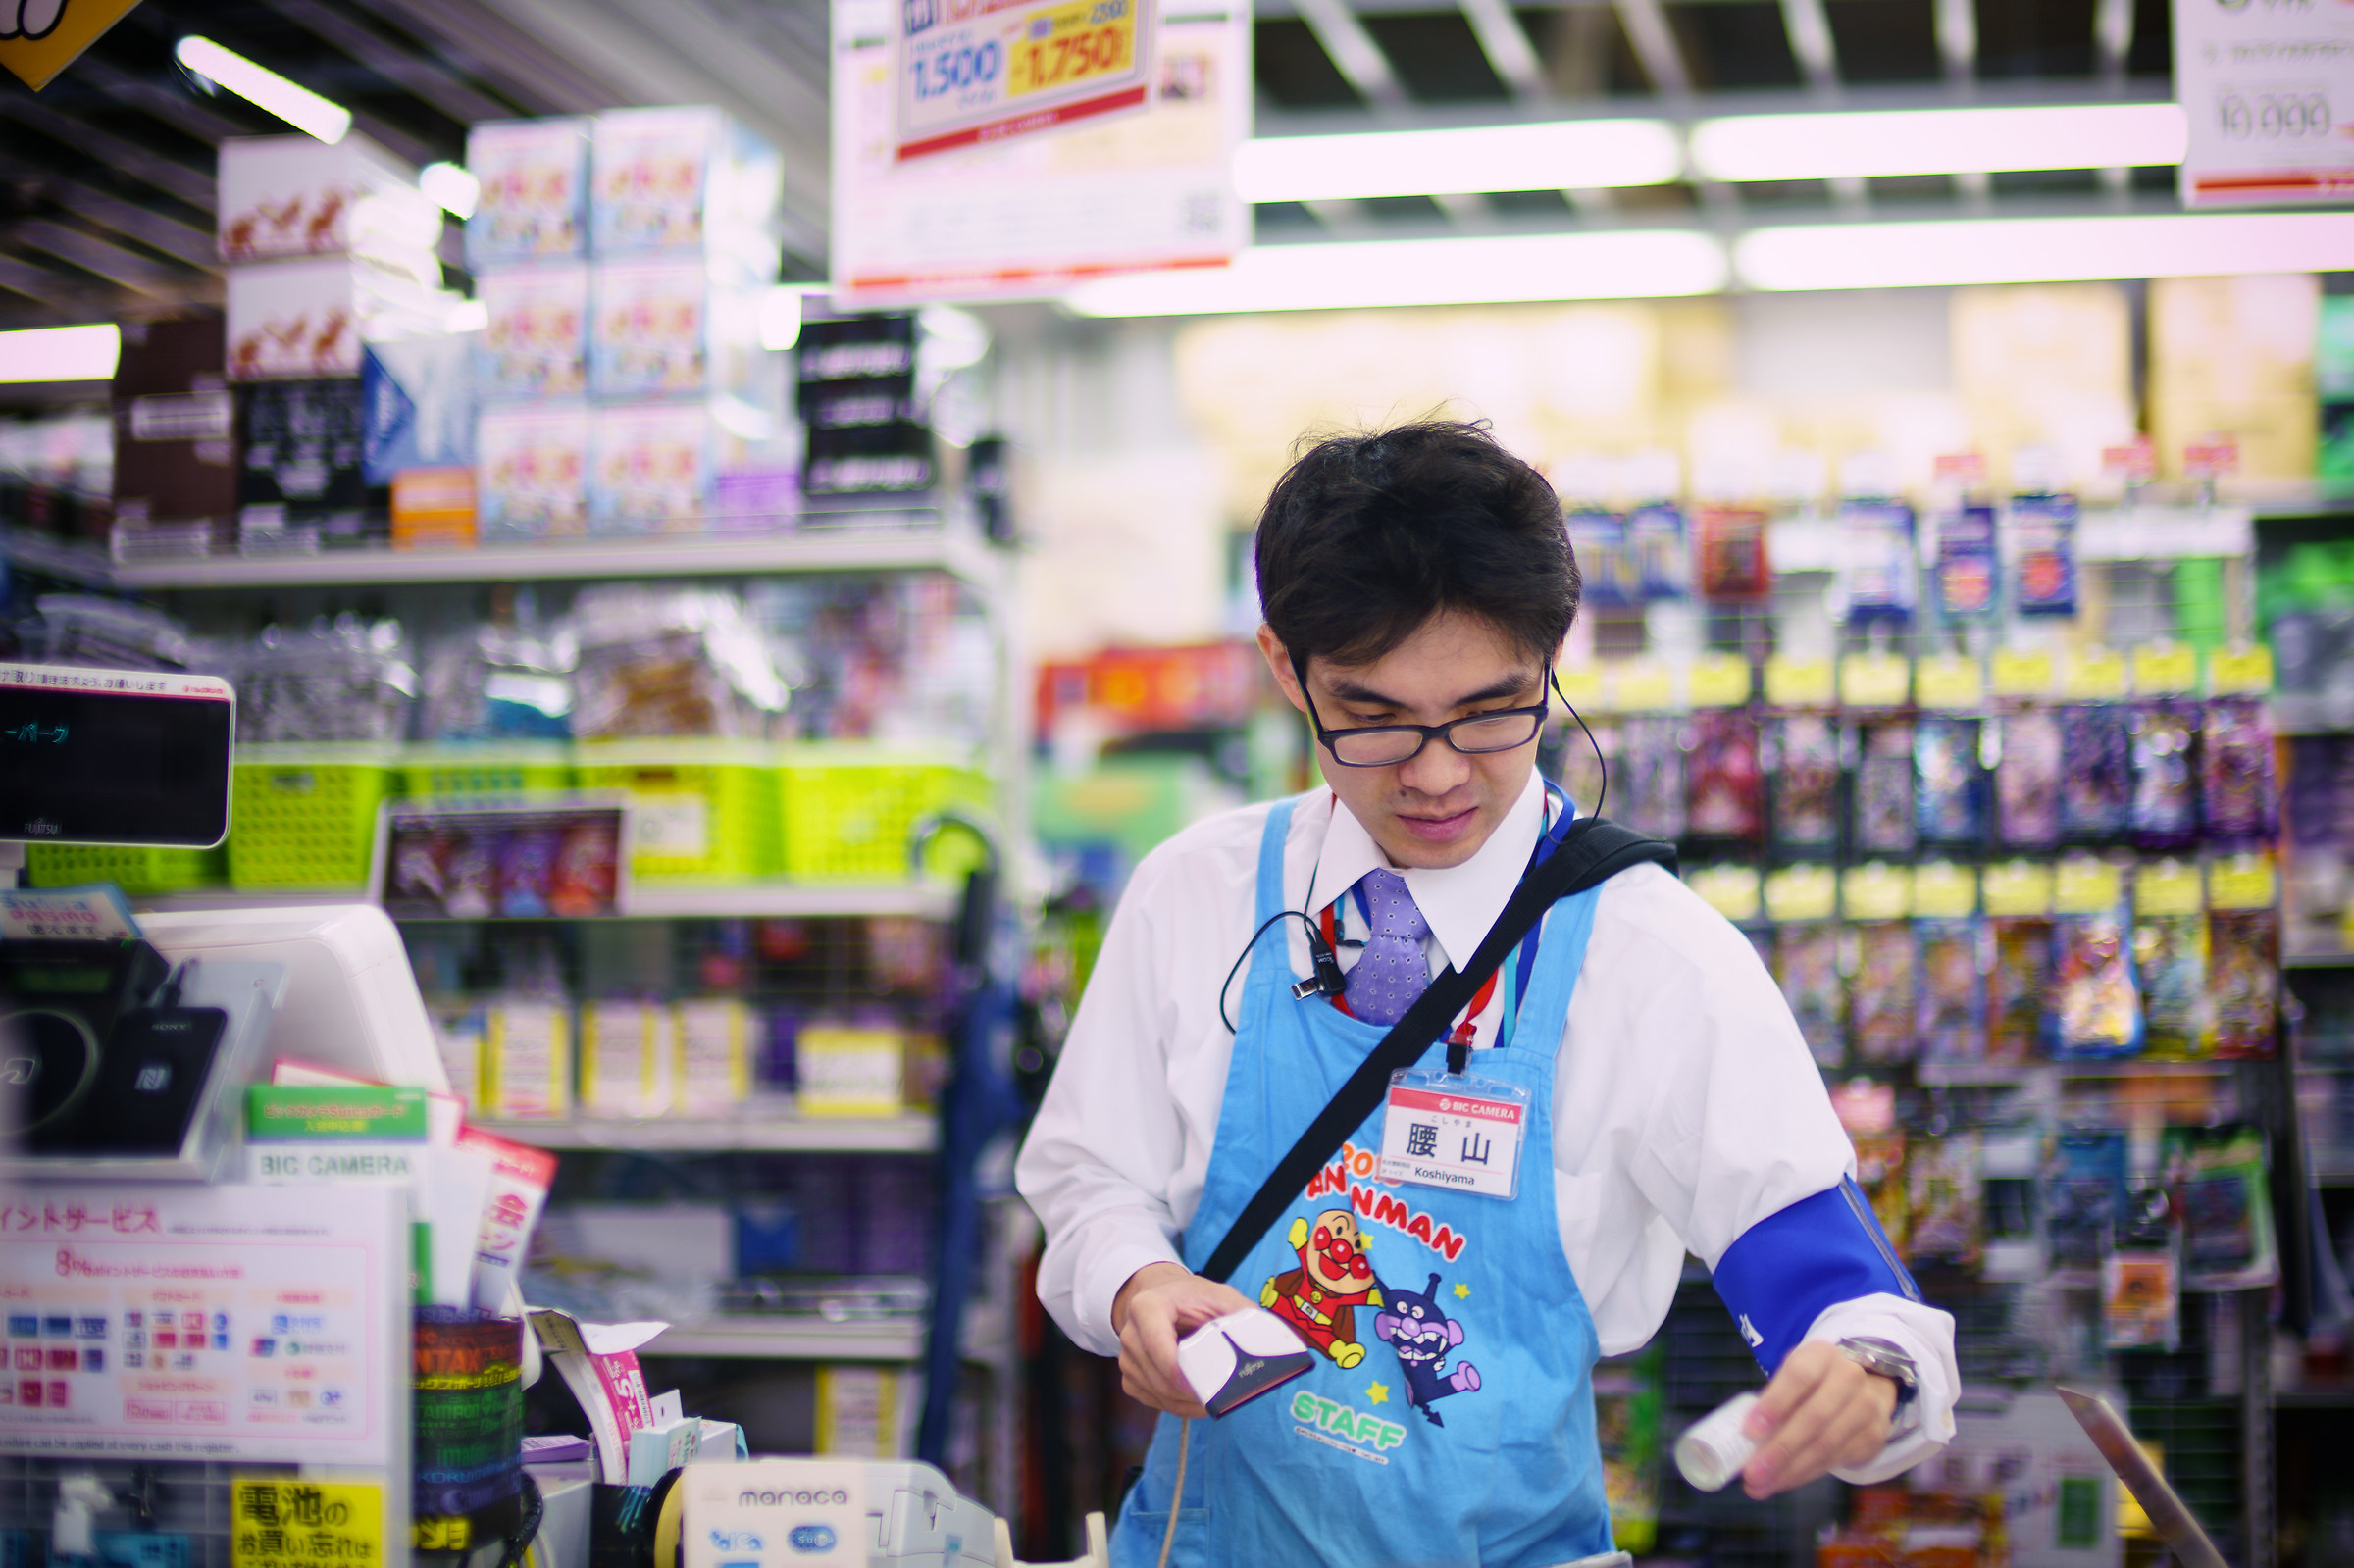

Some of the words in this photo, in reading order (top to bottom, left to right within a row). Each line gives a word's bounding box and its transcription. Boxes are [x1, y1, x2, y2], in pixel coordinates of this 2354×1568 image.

[1452, 1101, 1469, 1113] BIC
[1470, 1104, 1515, 1120] CAMERA
[260, 1155, 298, 1177] BIC
[307, 1155, 409, 1177] CAMERA
[1414, 1166, 1475, 1186] Koshiyama
[1293, 1392, 1405, 1449] STAFF
[238, 1485, 349, 1528] 電池の
[738, 1490, 848, 1507] manaca
[237, 1530, 372, 1559] お買い忘れは
